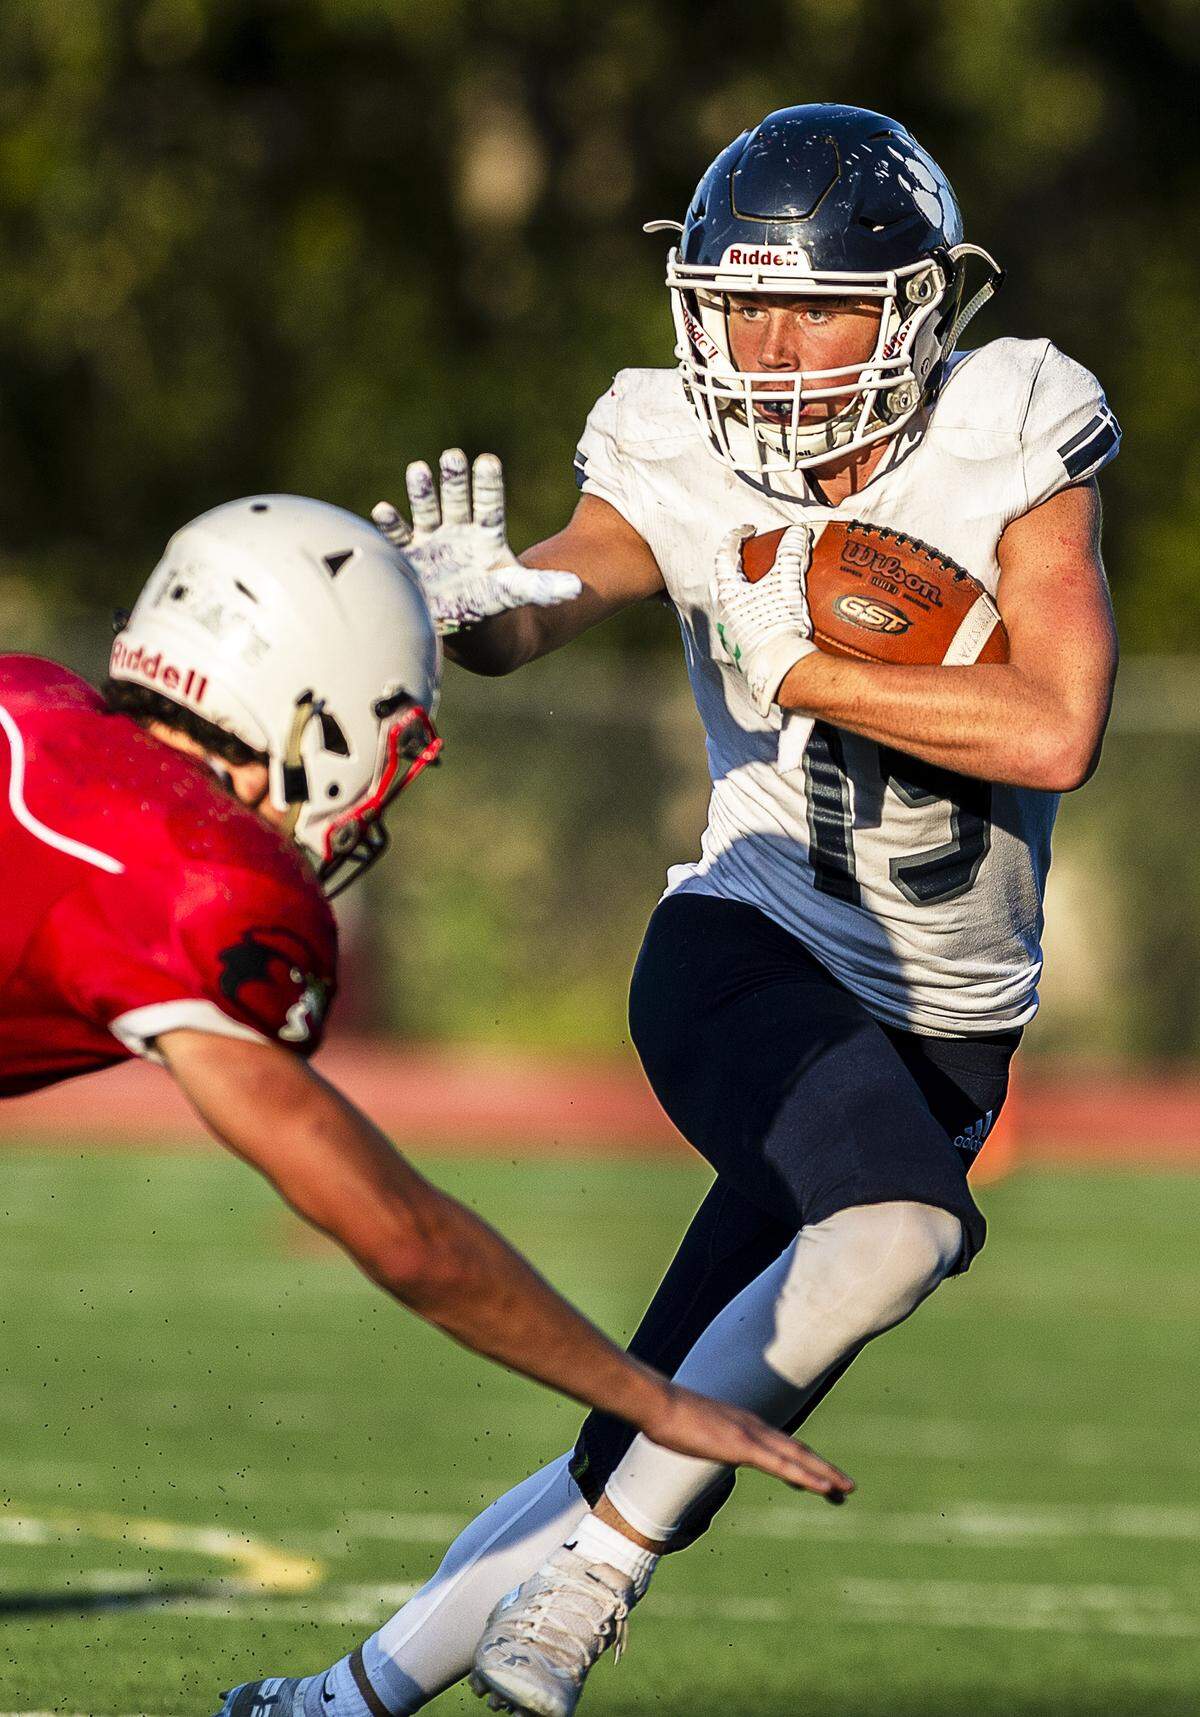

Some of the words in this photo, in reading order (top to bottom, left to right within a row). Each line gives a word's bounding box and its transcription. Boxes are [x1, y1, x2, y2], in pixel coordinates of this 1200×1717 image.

[841, 539, 945, 608] Wilson
[839, 595, 909, 632] GST
[111, 640, 208, 703] Riddell
